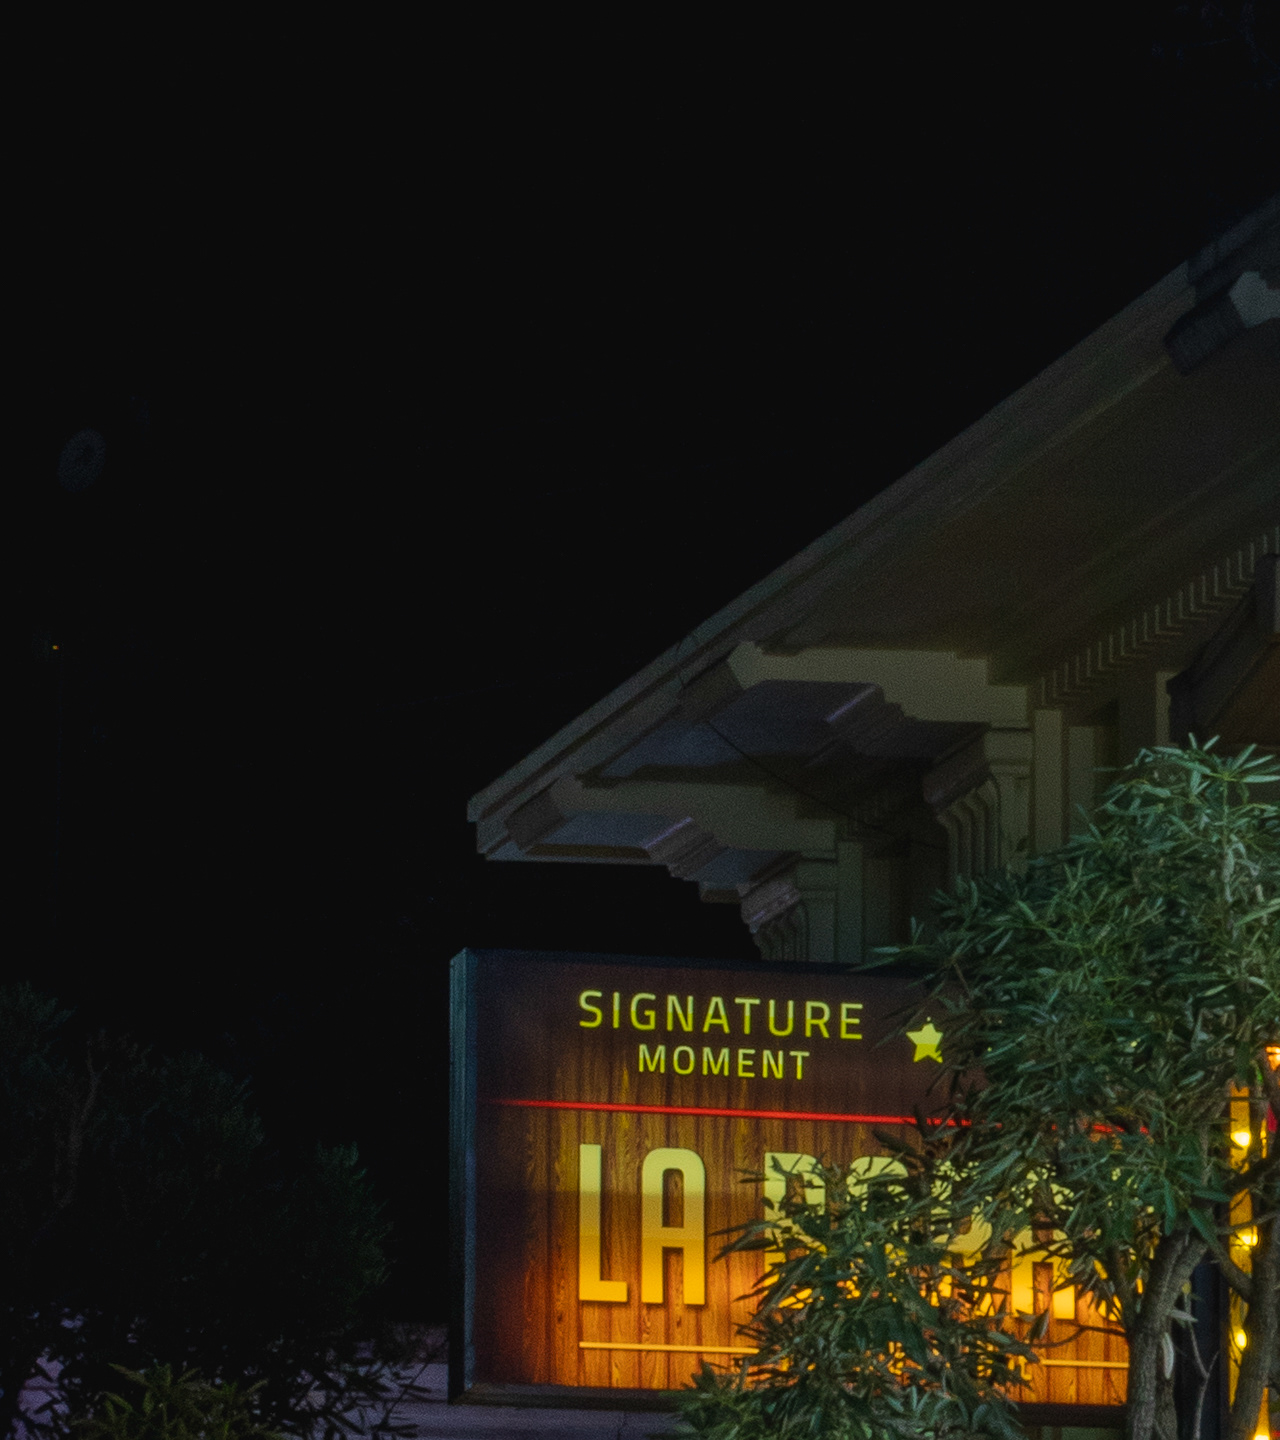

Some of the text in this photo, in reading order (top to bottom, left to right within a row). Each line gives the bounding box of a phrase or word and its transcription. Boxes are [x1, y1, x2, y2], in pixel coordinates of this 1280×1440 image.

[579, 990, 864, 1041] SIGNATURE
[638, 1043, 810, 1081] MOMENT
[579, 1144, 707, 1306] LA
